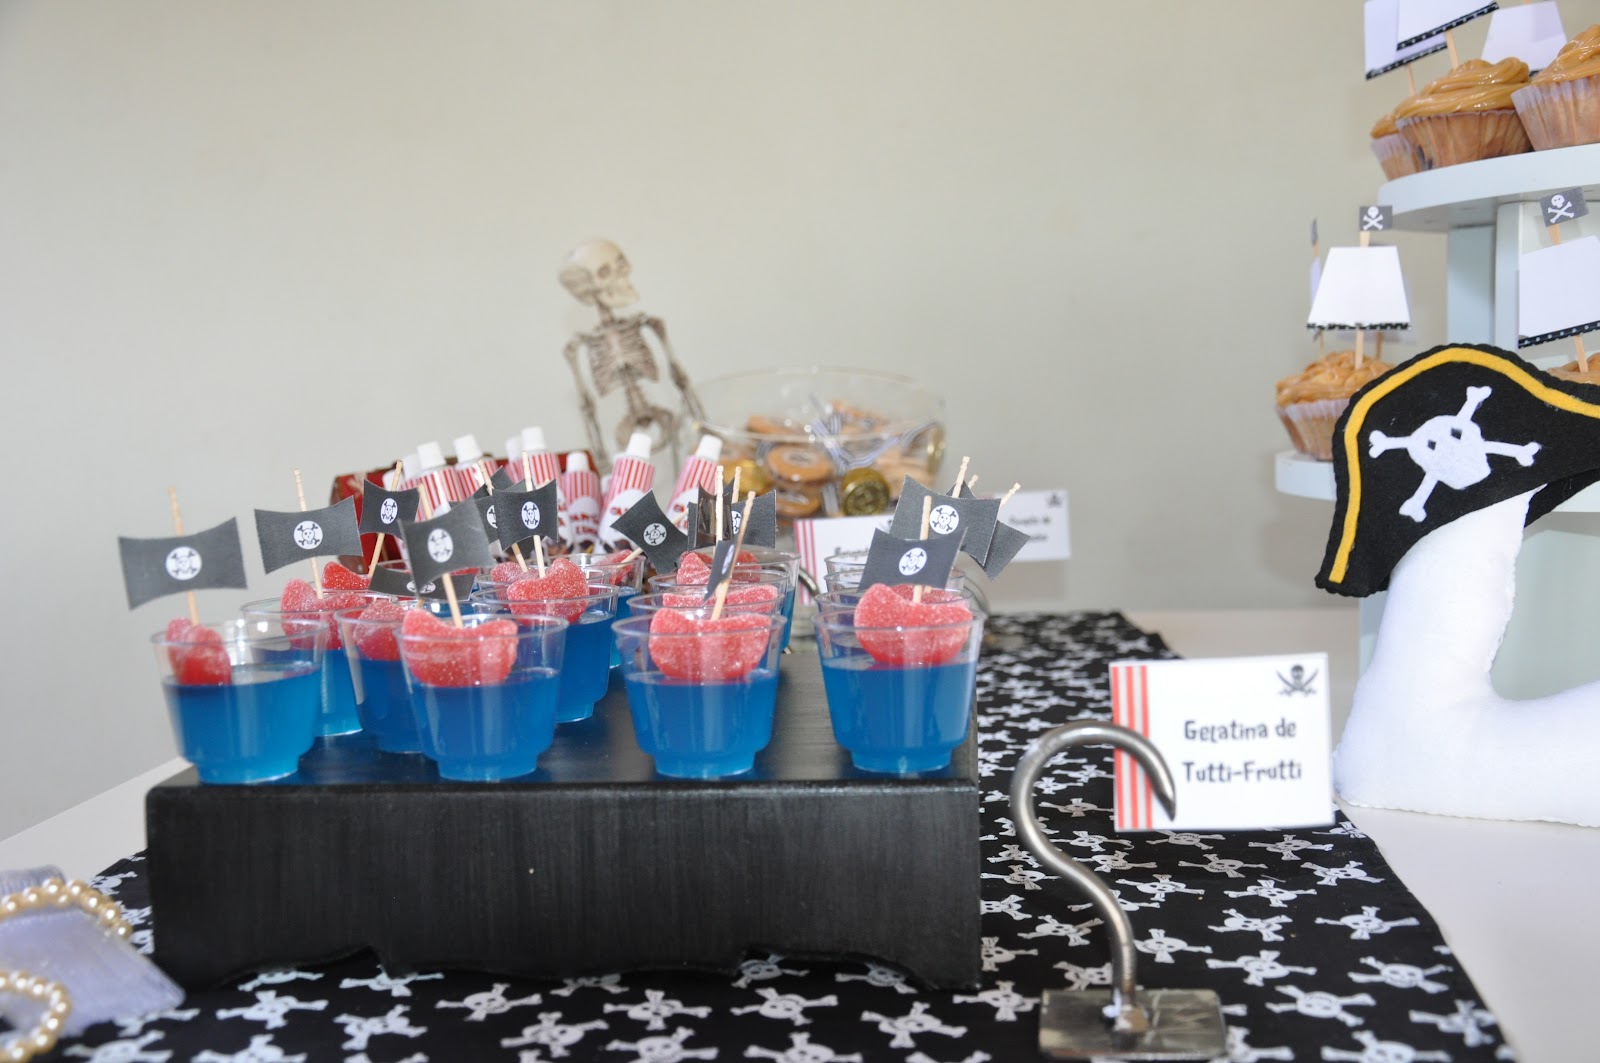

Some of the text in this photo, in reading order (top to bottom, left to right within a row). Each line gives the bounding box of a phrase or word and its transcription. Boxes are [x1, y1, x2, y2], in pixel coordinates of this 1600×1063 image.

[1184, 717, 1297, 743] Gelatina de
[1182, 759, 1303, 783] Tutti-Frutti
